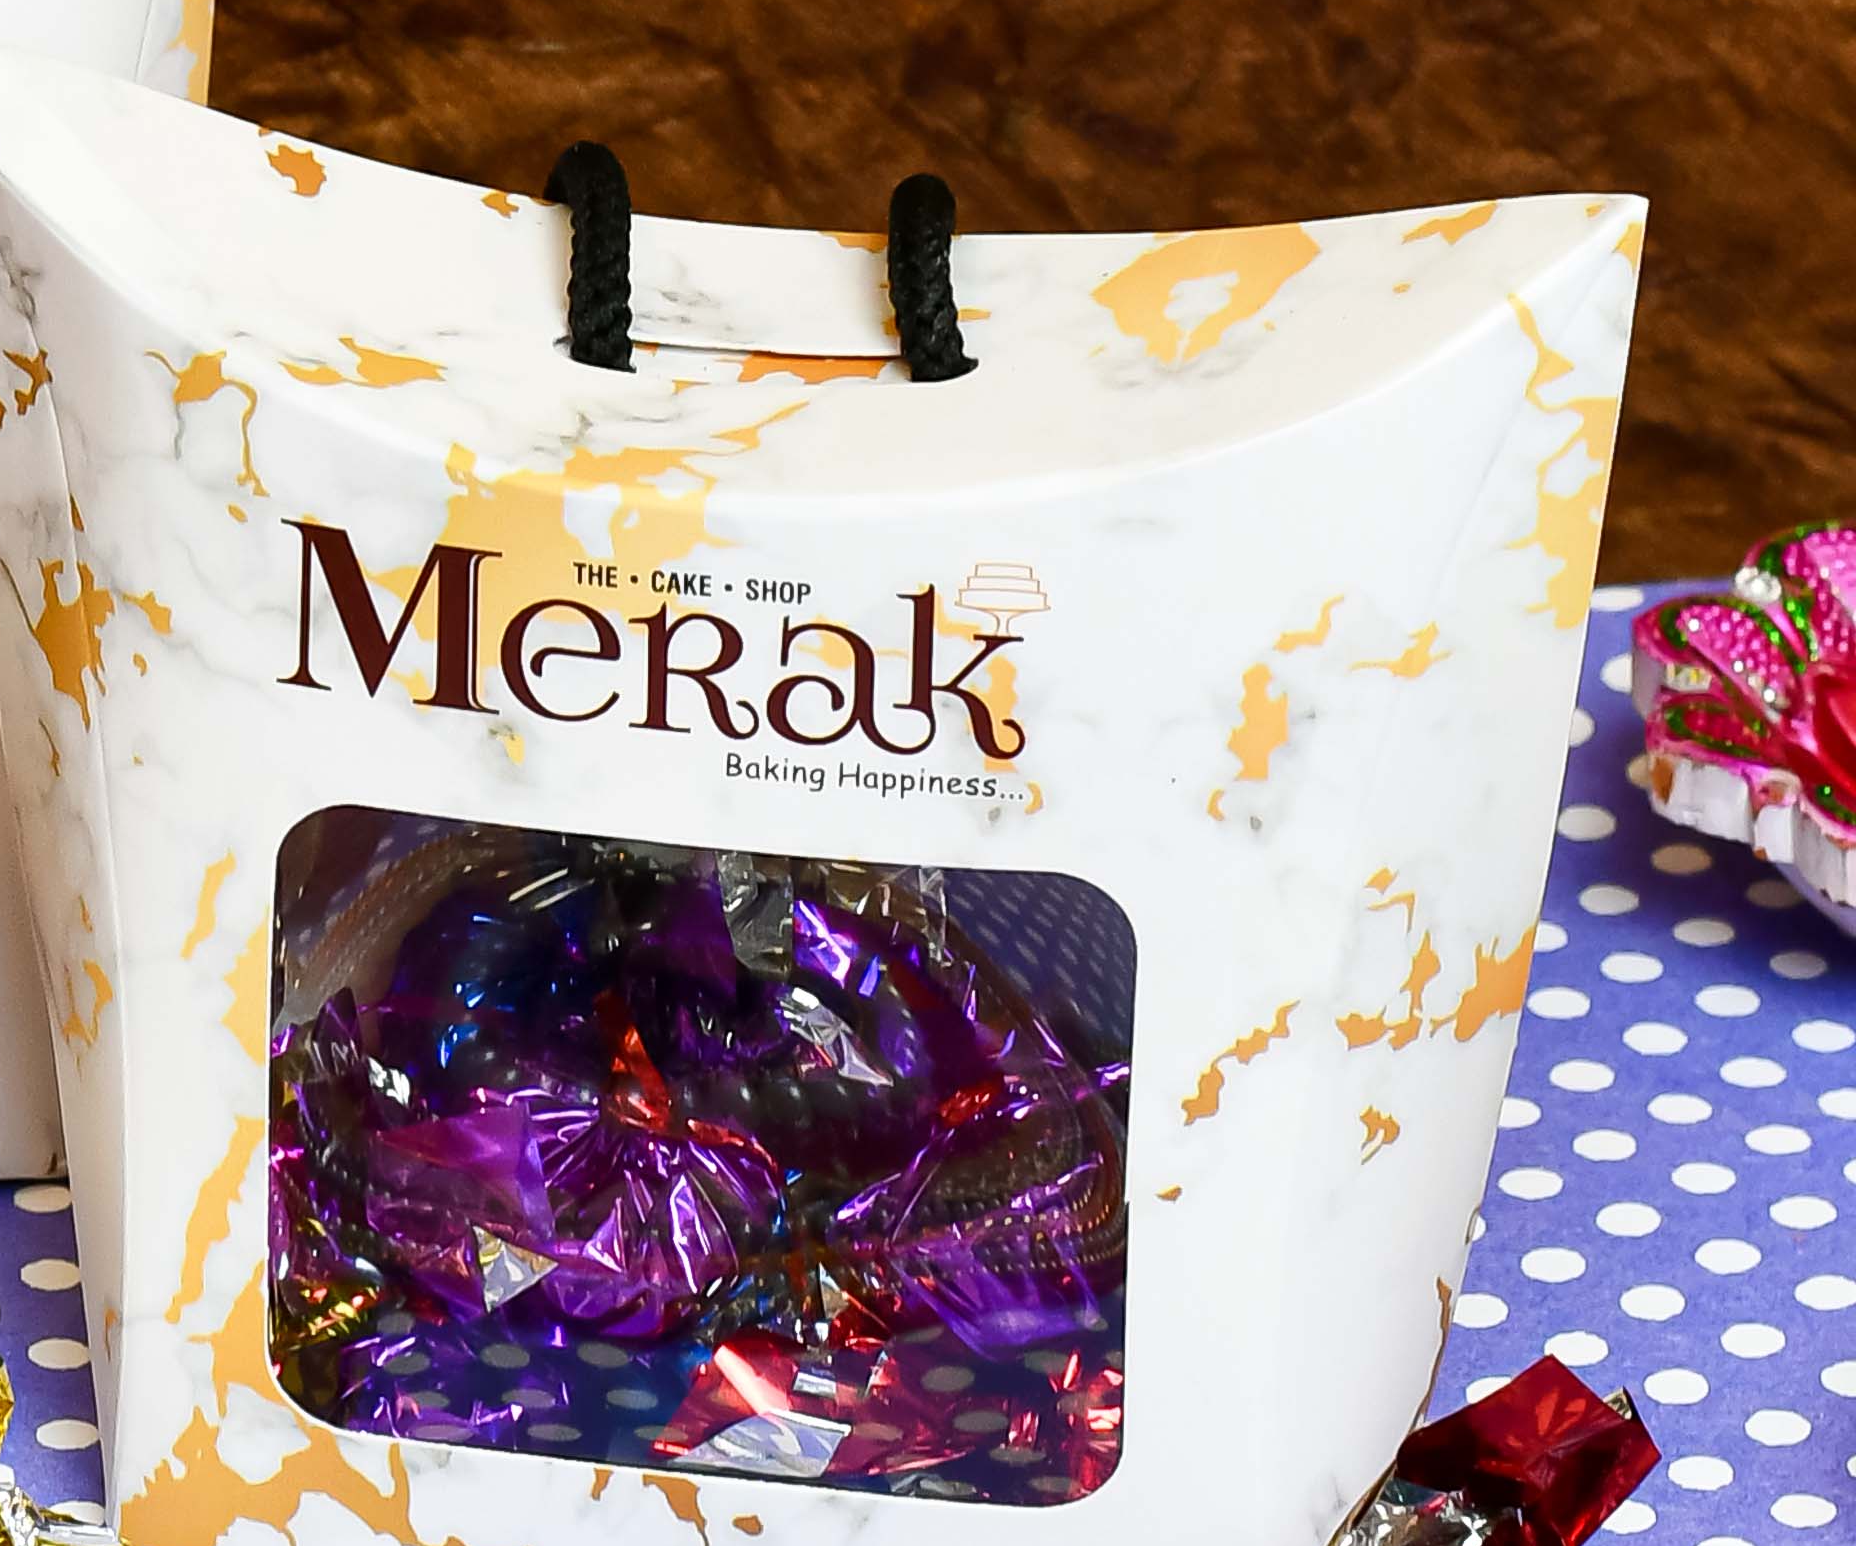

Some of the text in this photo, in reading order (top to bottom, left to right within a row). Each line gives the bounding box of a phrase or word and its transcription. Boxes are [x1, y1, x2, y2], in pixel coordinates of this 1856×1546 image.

[573, 562, 812, 605] THE CAKE SHOP
[725, 752, 1025, 801] Baking Happiness...
